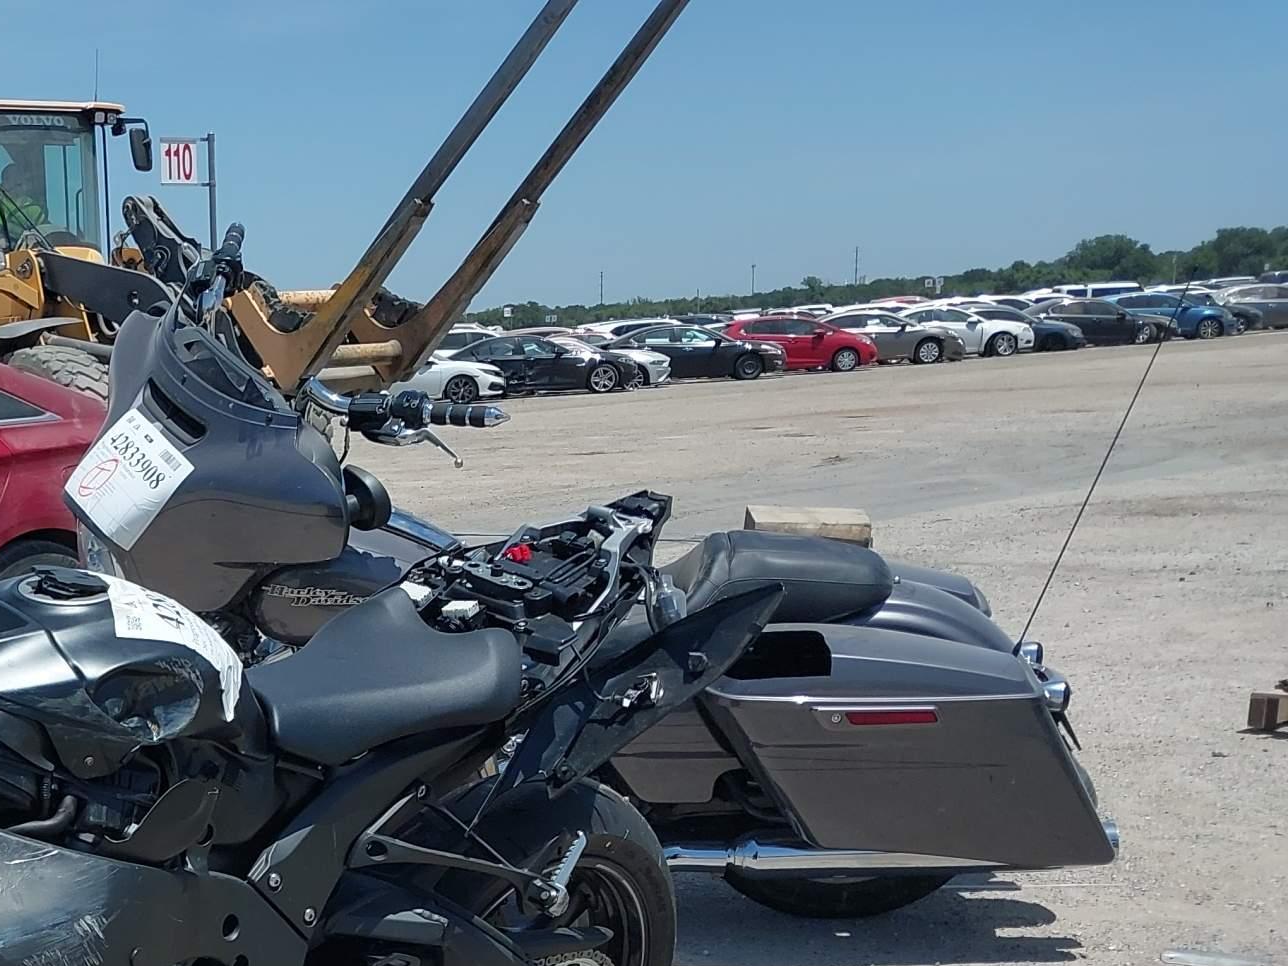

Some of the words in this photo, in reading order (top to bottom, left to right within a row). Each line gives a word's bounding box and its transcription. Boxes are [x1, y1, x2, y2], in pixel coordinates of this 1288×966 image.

[6, 115, 64, 126] VOLVO
[165, 143, 192, 180] 110
[109, 432, 166, 490] 42833908
